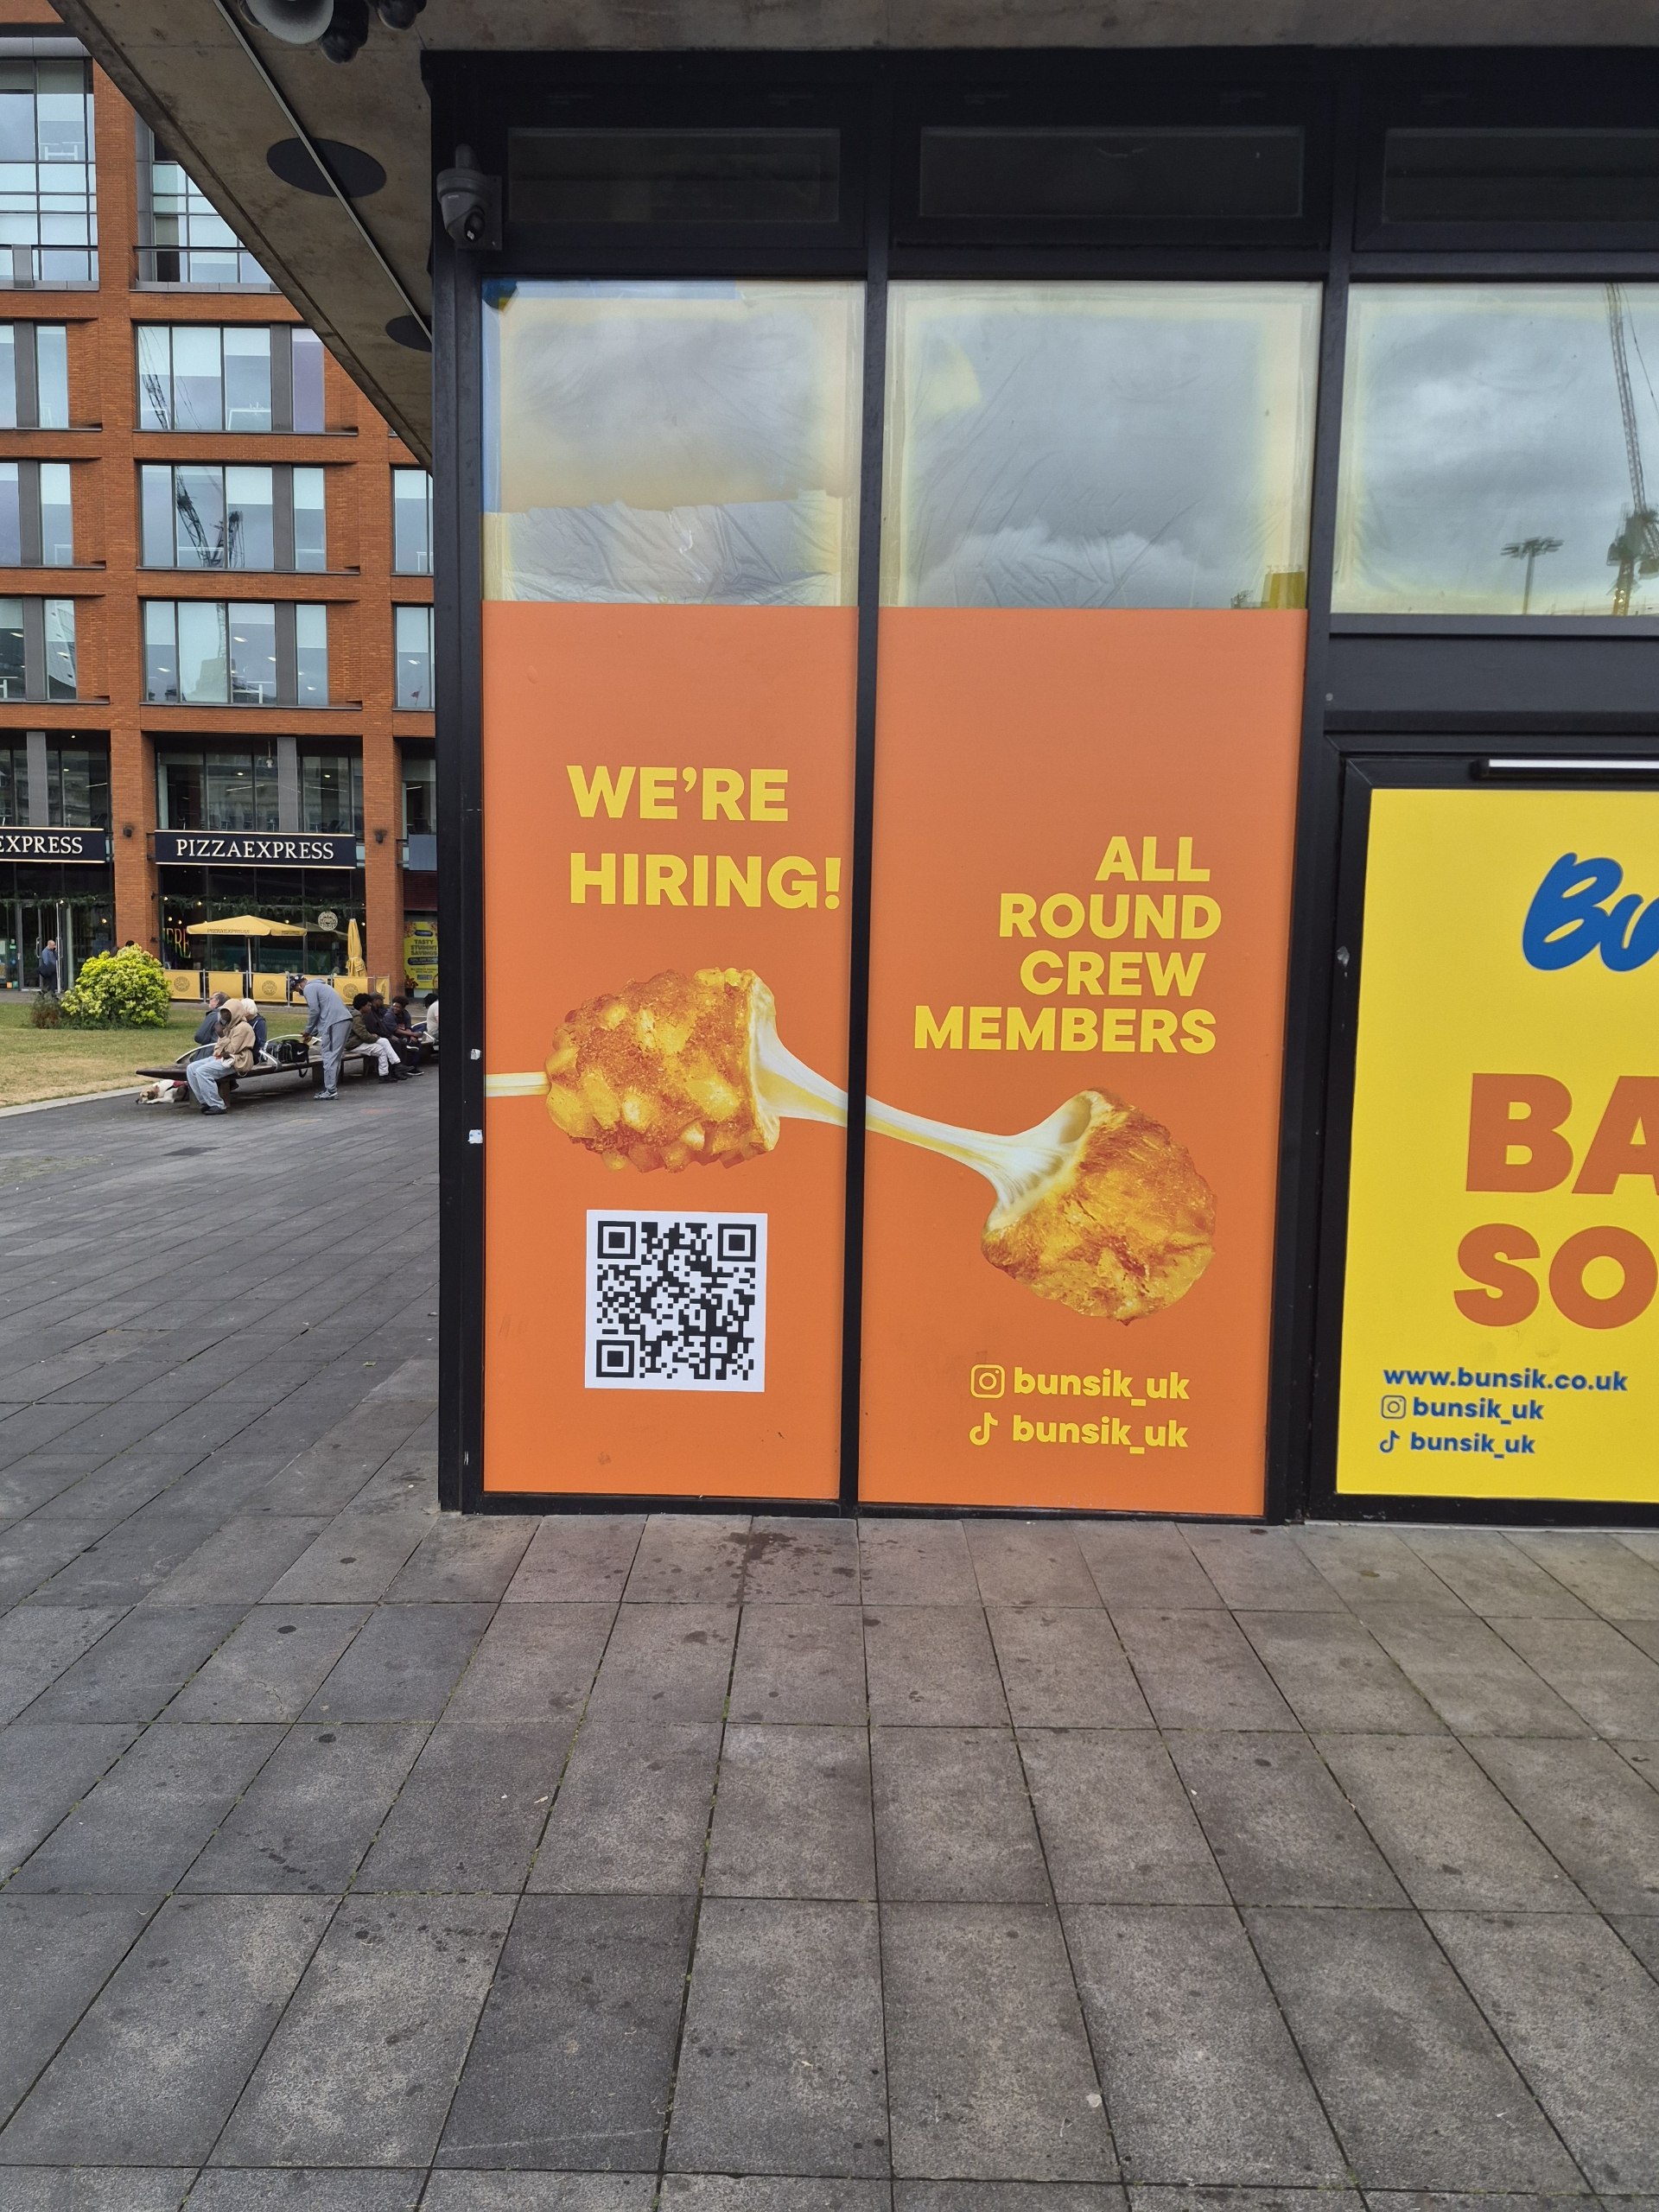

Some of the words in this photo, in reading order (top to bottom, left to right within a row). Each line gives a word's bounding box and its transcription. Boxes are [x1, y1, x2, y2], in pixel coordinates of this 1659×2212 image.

[567, 765, 788, 823] WE’RE
[175, 838, 335, 860] PIZZAEXPRESS
[1096, 836, 1211, 883] ALL
[569, 852, 842, 911] HIRING!
[999, 893, 1222, 941] ROUND
[1020, 949, 1206, 997] CREW
[913, 1005, 1216, 1056] MEMBERS
[1465, 1072, 1659, 1196] BA
[1453, 1223, 1658, 1330] SO
[1014, 1367, 1190, 1408] bunsik_uk
[1383, 1367, 1628, 1391] www.bunsik.co.uk
[1413, 1396, 1544, 1425] bunsik_uk
[1012, 1414, 1188, 1456] bunsik_uk
[1410, 1431, 1535, 1459] bunsik_uk
